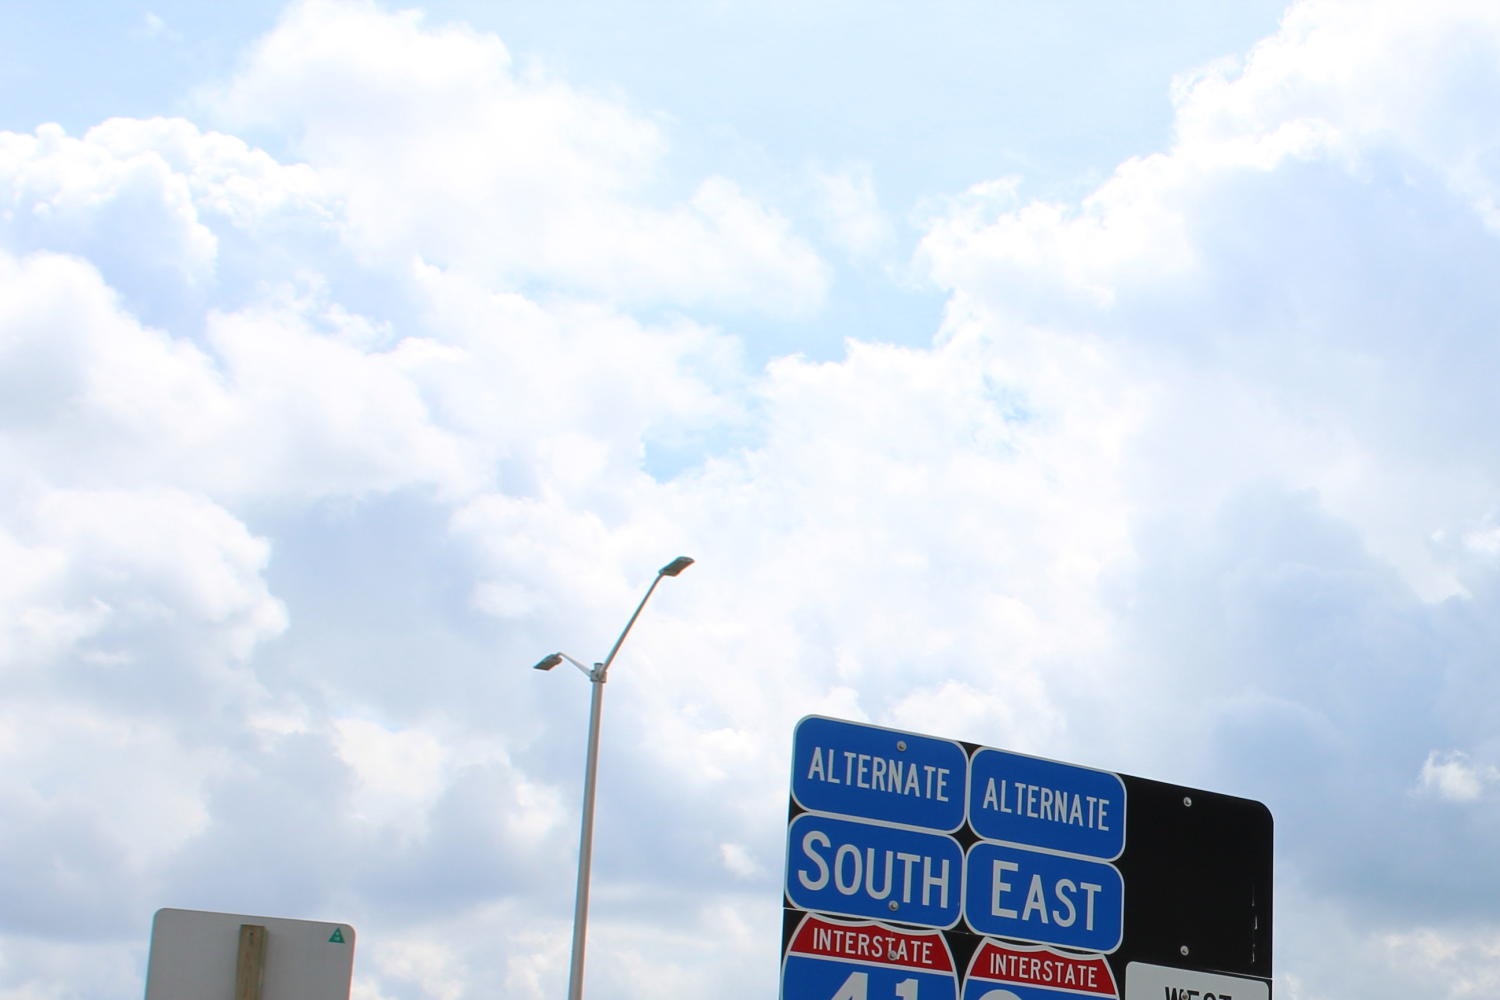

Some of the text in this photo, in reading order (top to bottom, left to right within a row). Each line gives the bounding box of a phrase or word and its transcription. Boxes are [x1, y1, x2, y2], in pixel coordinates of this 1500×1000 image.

[808, 747, 950, 802] ALTERNATE
[982, 777, 1110, 831] ALTERNATE
[797, 830, 950, 909] SOUTH
[991, 859, 1102, 931] EAST
[812, 927, 933, 964] INTERSTATE
[989, 953, 1098, 988] INTERSTATE
